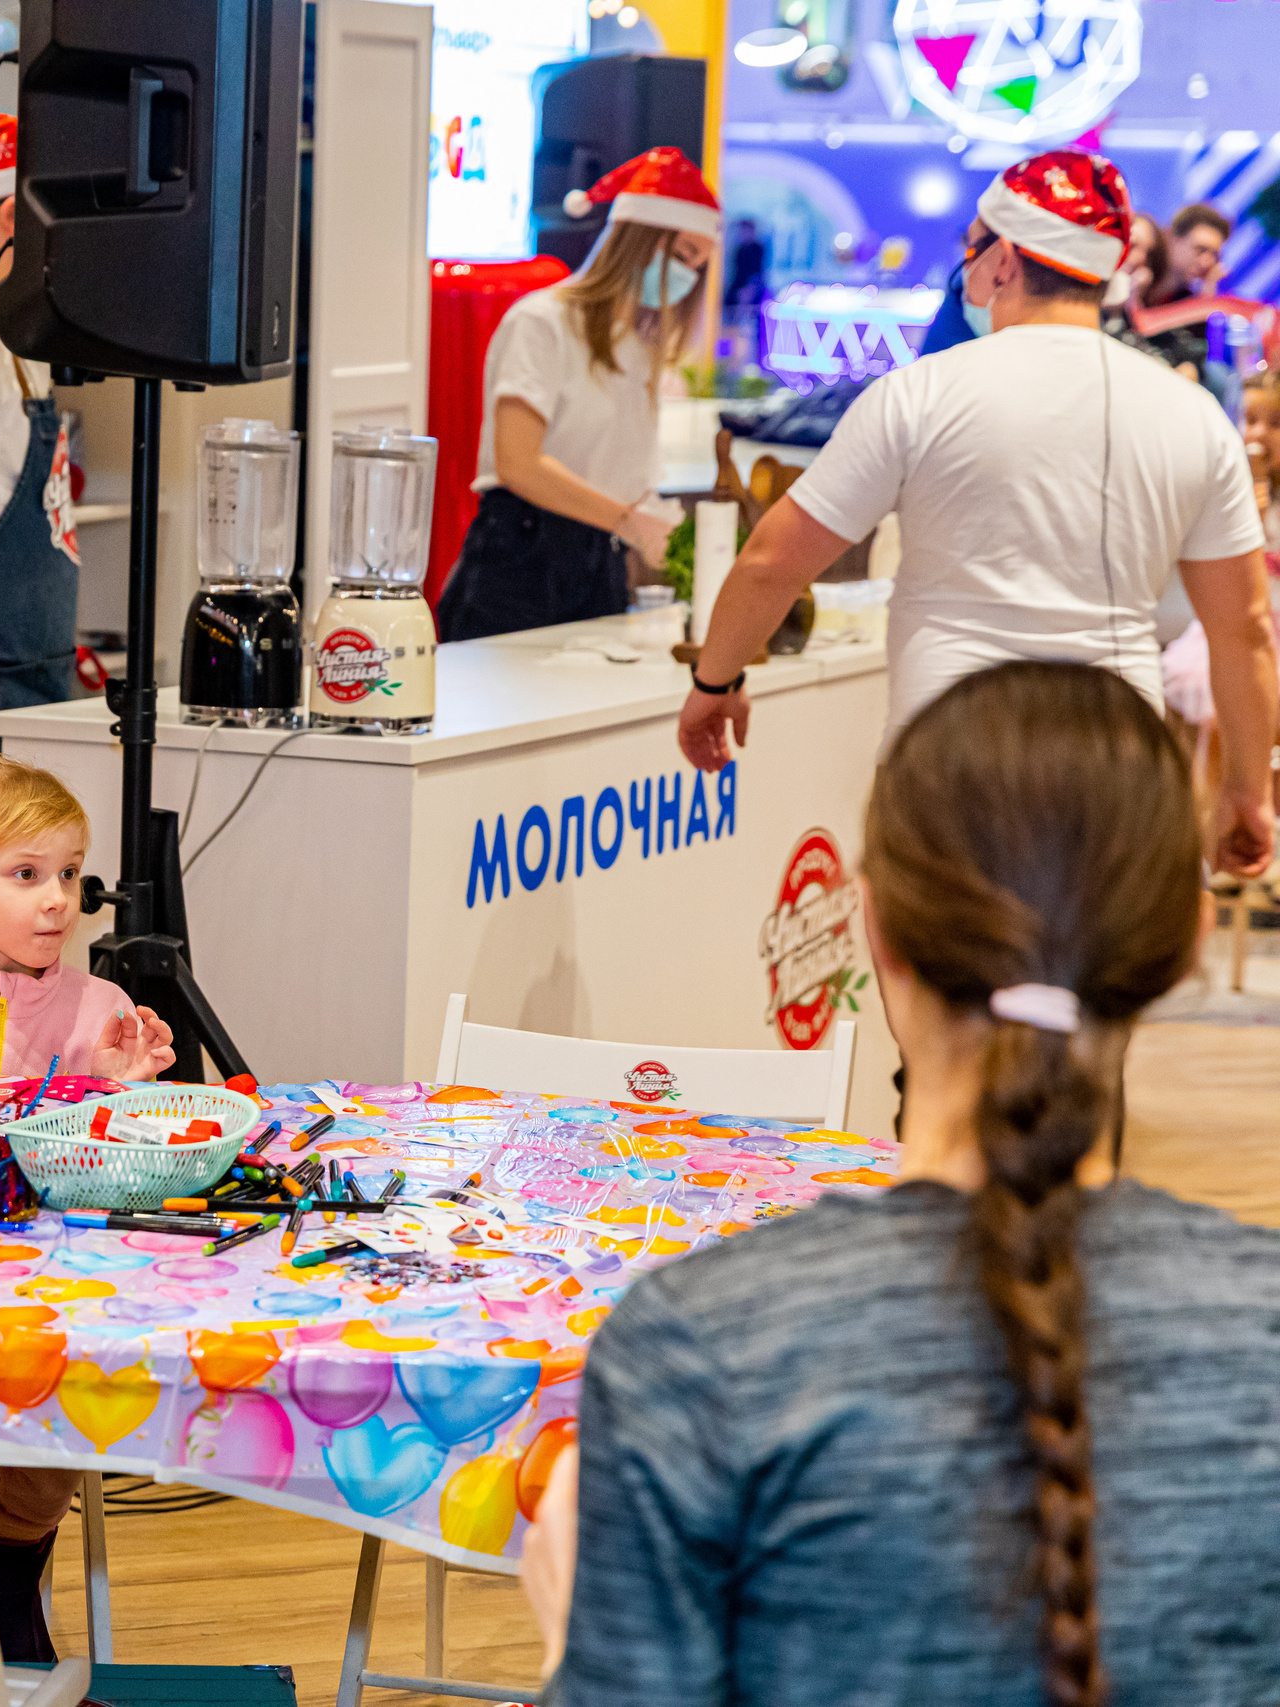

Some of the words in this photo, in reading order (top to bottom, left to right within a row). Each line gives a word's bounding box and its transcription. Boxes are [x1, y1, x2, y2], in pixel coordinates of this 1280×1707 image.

[466, 760, 737, 909] МОЛОЧНАЯ
[624, 1070, 678, 1082] Чистая
[626, 1081, 675, 1092] Линия
